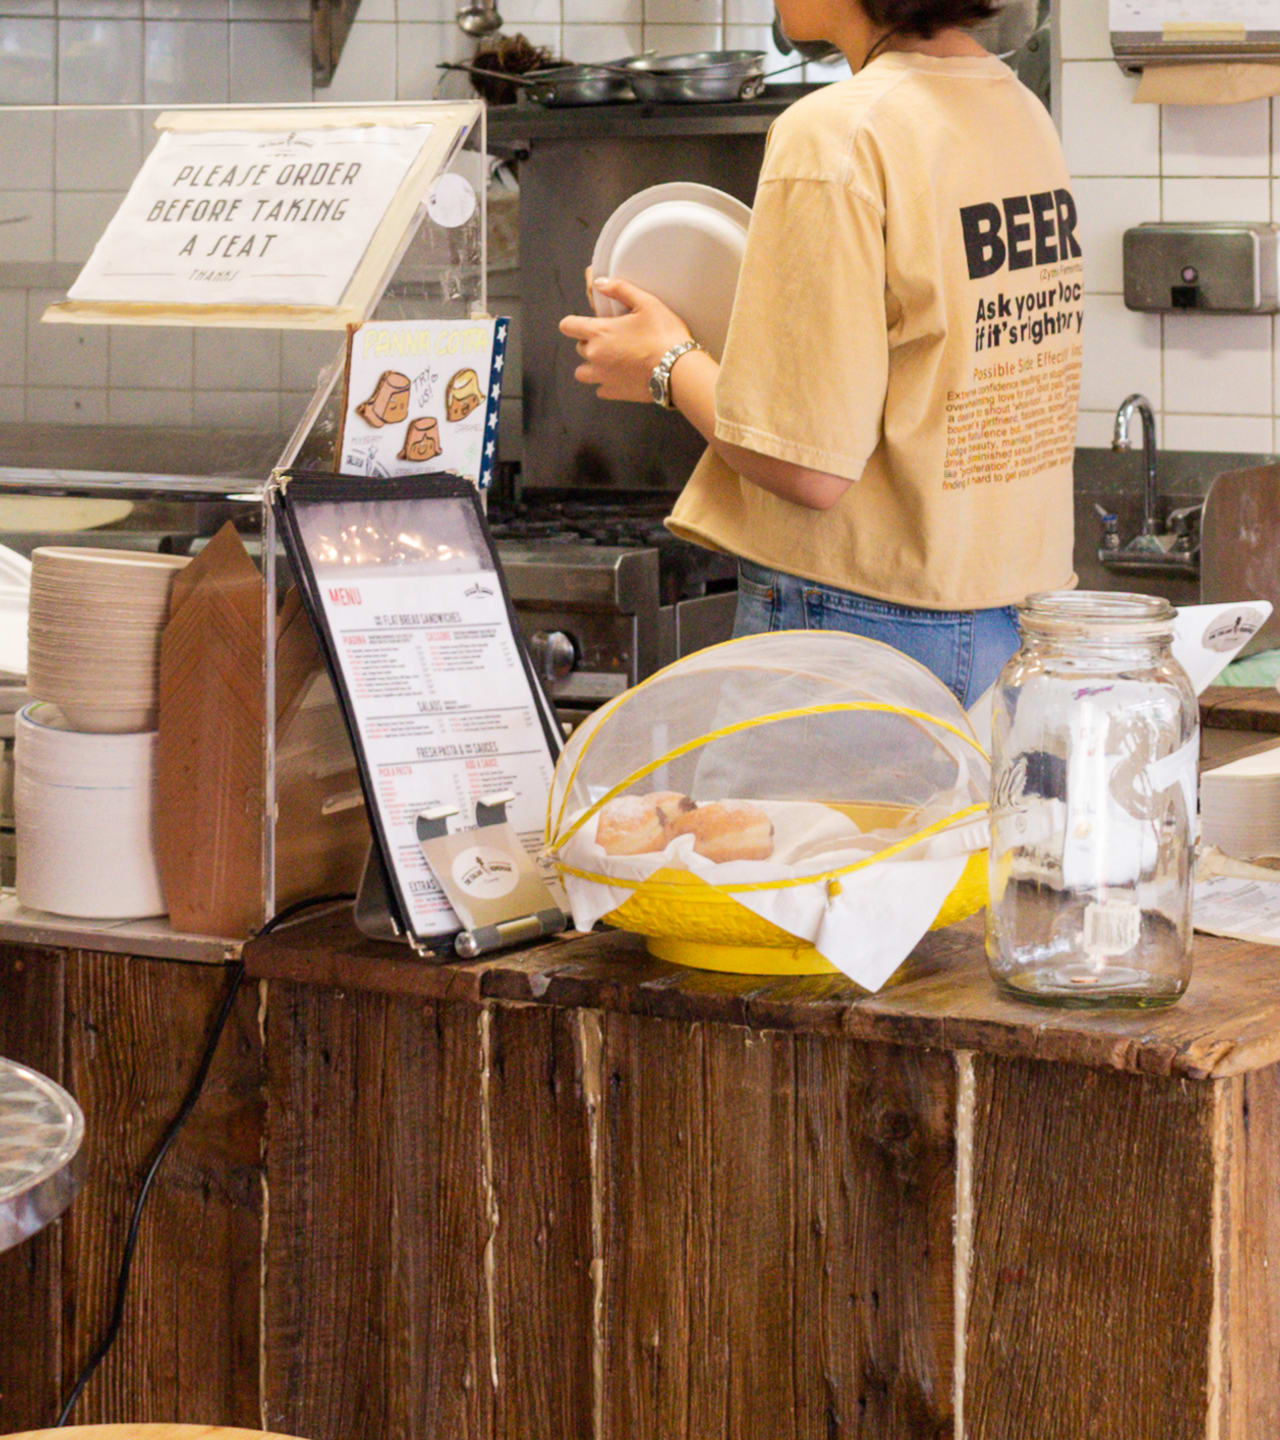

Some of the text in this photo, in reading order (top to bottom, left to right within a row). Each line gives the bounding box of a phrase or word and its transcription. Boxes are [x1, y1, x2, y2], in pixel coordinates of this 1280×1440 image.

[173, 162, 362, 187] PLEASE ORDER
[147, 198, 351, 222] BEFORE TAKING
[959, 188, 1082, 280] BEER
[178, 234, 279, 258] A SEAT
[188, 269, 239, 281] THANKS
[975, 292, 1011, 324] Ask
[1015, 287, 1057, 321] your
[975, 312, 1062, 352] if it's right
[362, 328, 489, 359] PANNA COTTA
[412, 365, 432, 393] TRY
[973, 361, 1015, 380] Possible
[418, 387, 434, 408] US!
[328, 587, 362, 606] MENU
[400, 613, 420, 626] BREAD
[420, 611, 462, 624] SANDWICHES
[417, 701, 443, 712] SALADS
[416, 741, 499, 758] FRESH PASTA SAUCES
[409, 879, 438, 893] EXTRAS
